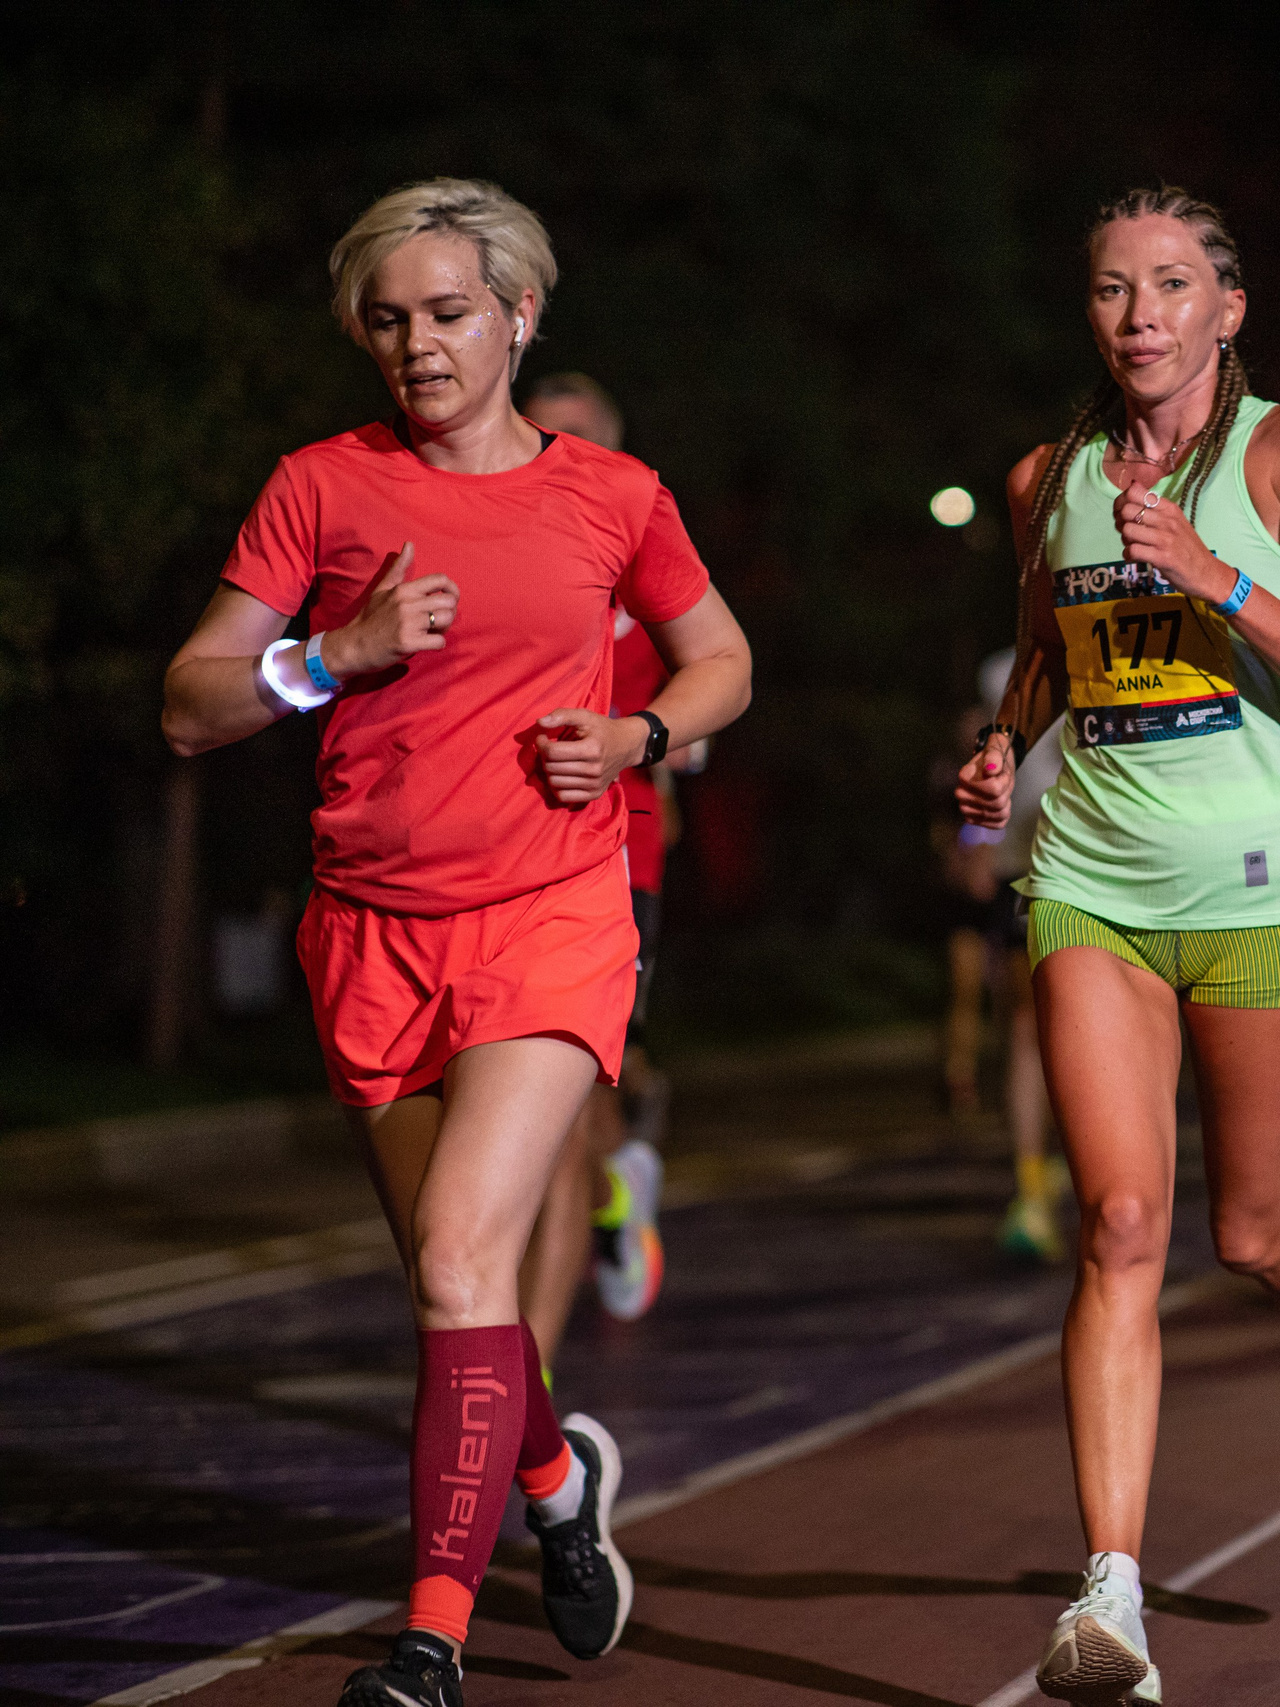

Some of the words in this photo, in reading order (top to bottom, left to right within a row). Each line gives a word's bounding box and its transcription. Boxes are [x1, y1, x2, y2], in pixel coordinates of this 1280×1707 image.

[1235, 578, 1252, 604] 177
[1092, 609, 1182, 672] 177
[1116, 674, 1163, 692] ANNA
